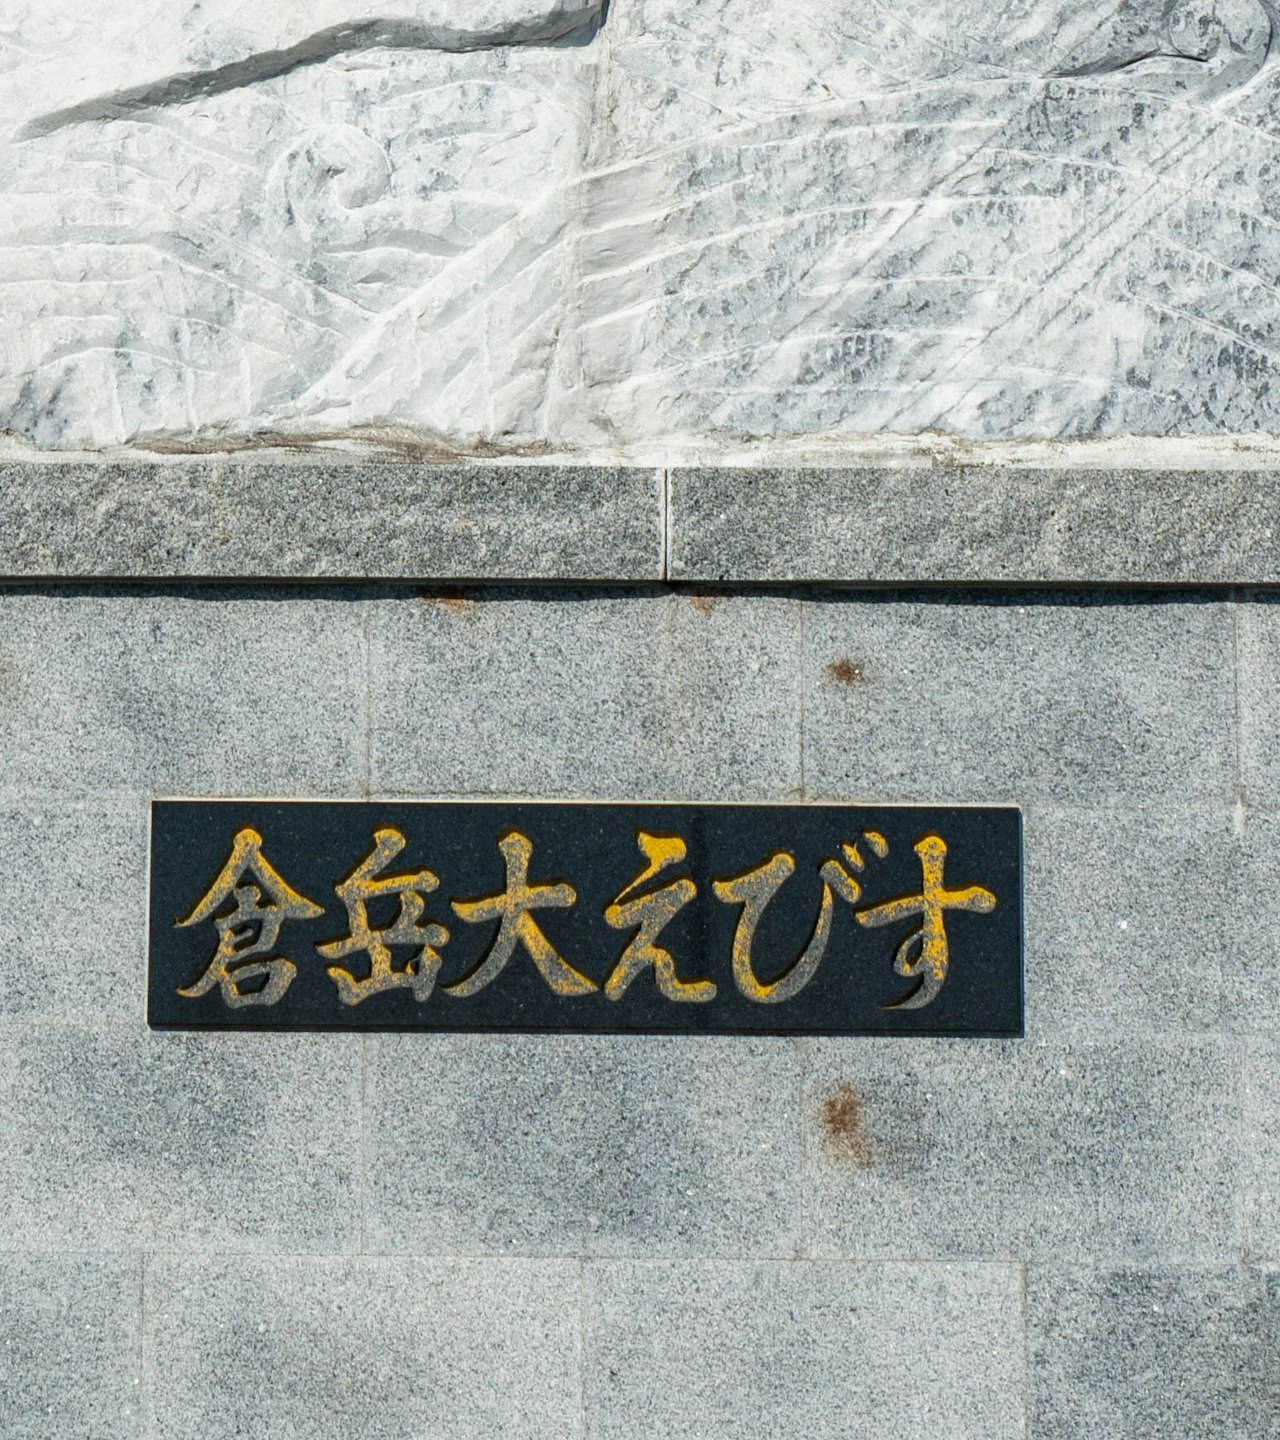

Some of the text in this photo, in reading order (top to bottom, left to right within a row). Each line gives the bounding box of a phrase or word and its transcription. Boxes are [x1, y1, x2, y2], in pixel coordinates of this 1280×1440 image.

[175, 826, 997, 1011] 倉岳大えびす
